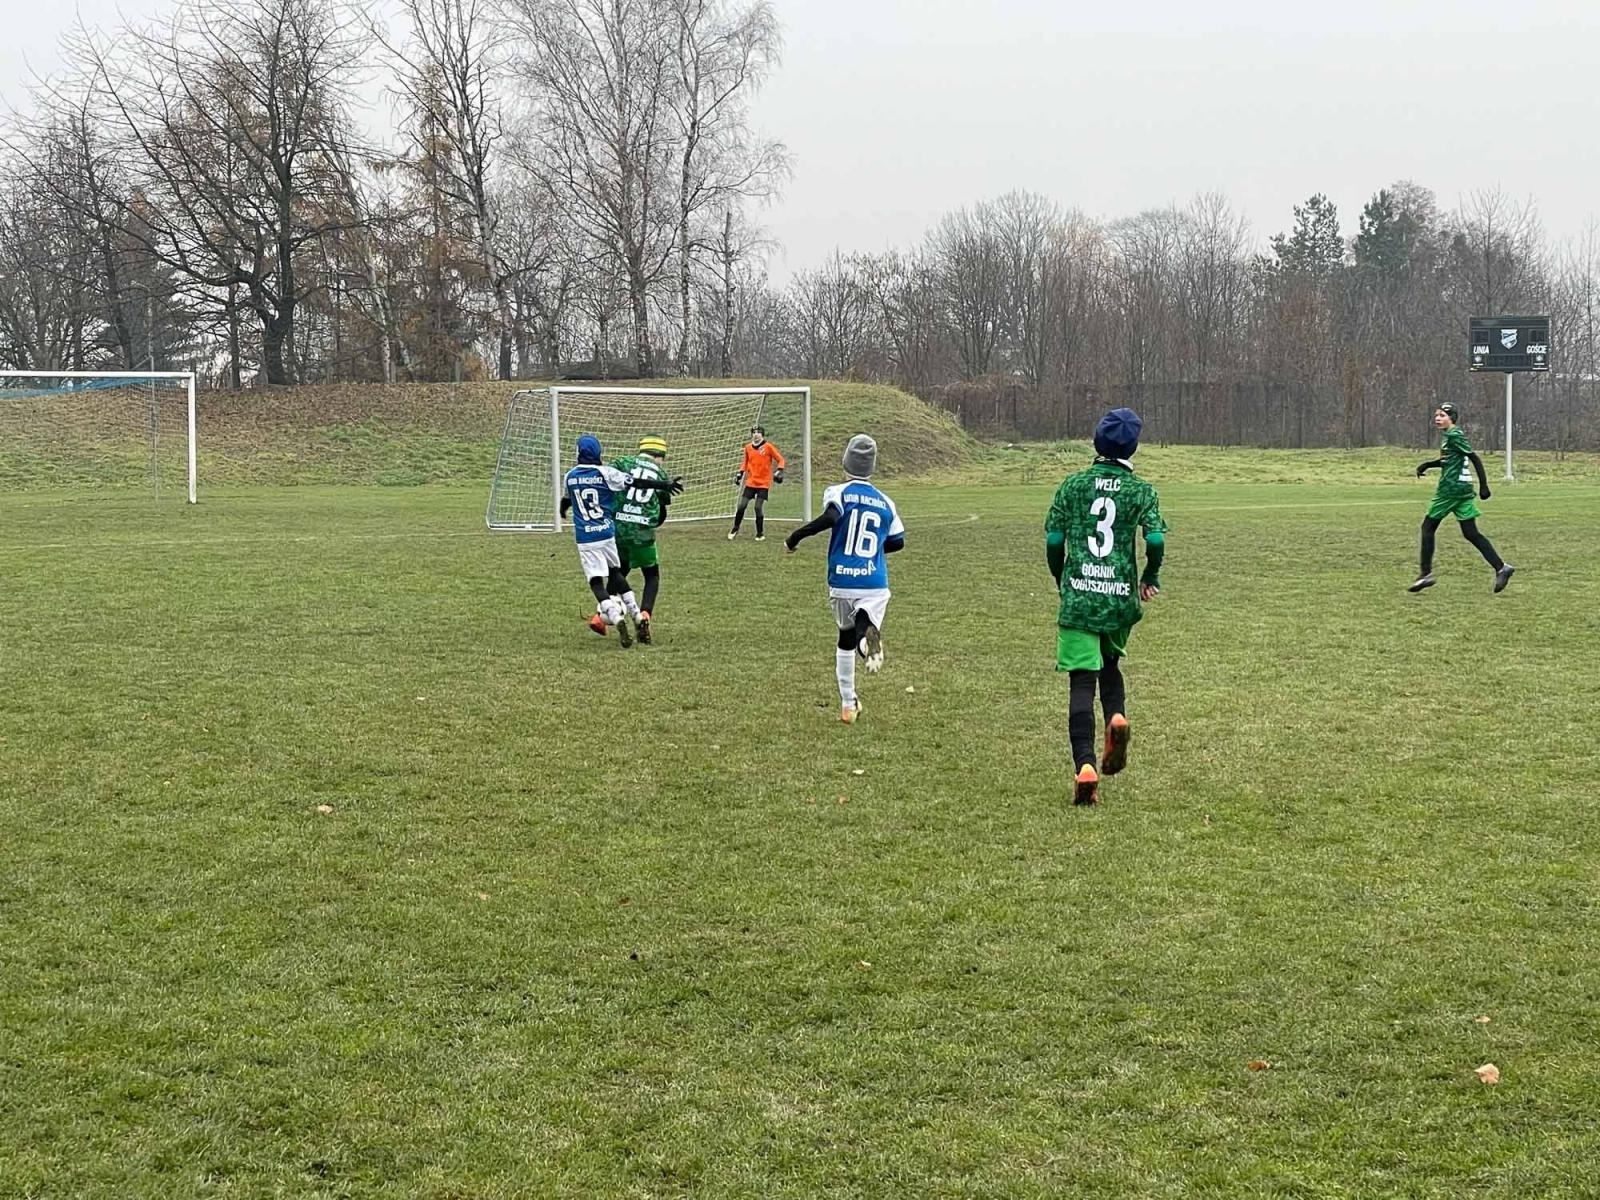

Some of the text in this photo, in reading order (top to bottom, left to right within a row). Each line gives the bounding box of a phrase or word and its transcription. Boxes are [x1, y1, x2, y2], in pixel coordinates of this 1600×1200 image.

[1473, 345, 1489, 354] UNIA
[1526, 343, 1547, 354] GOŚCIE
[1095, 477, 1121, 492] WELC
[574, 488, 604, 521] 13
[844, 508, 881, 558] 16
[1087, 496, 1117, 558] 3
[1081, 562, 1116, 578] GÓRNIK
